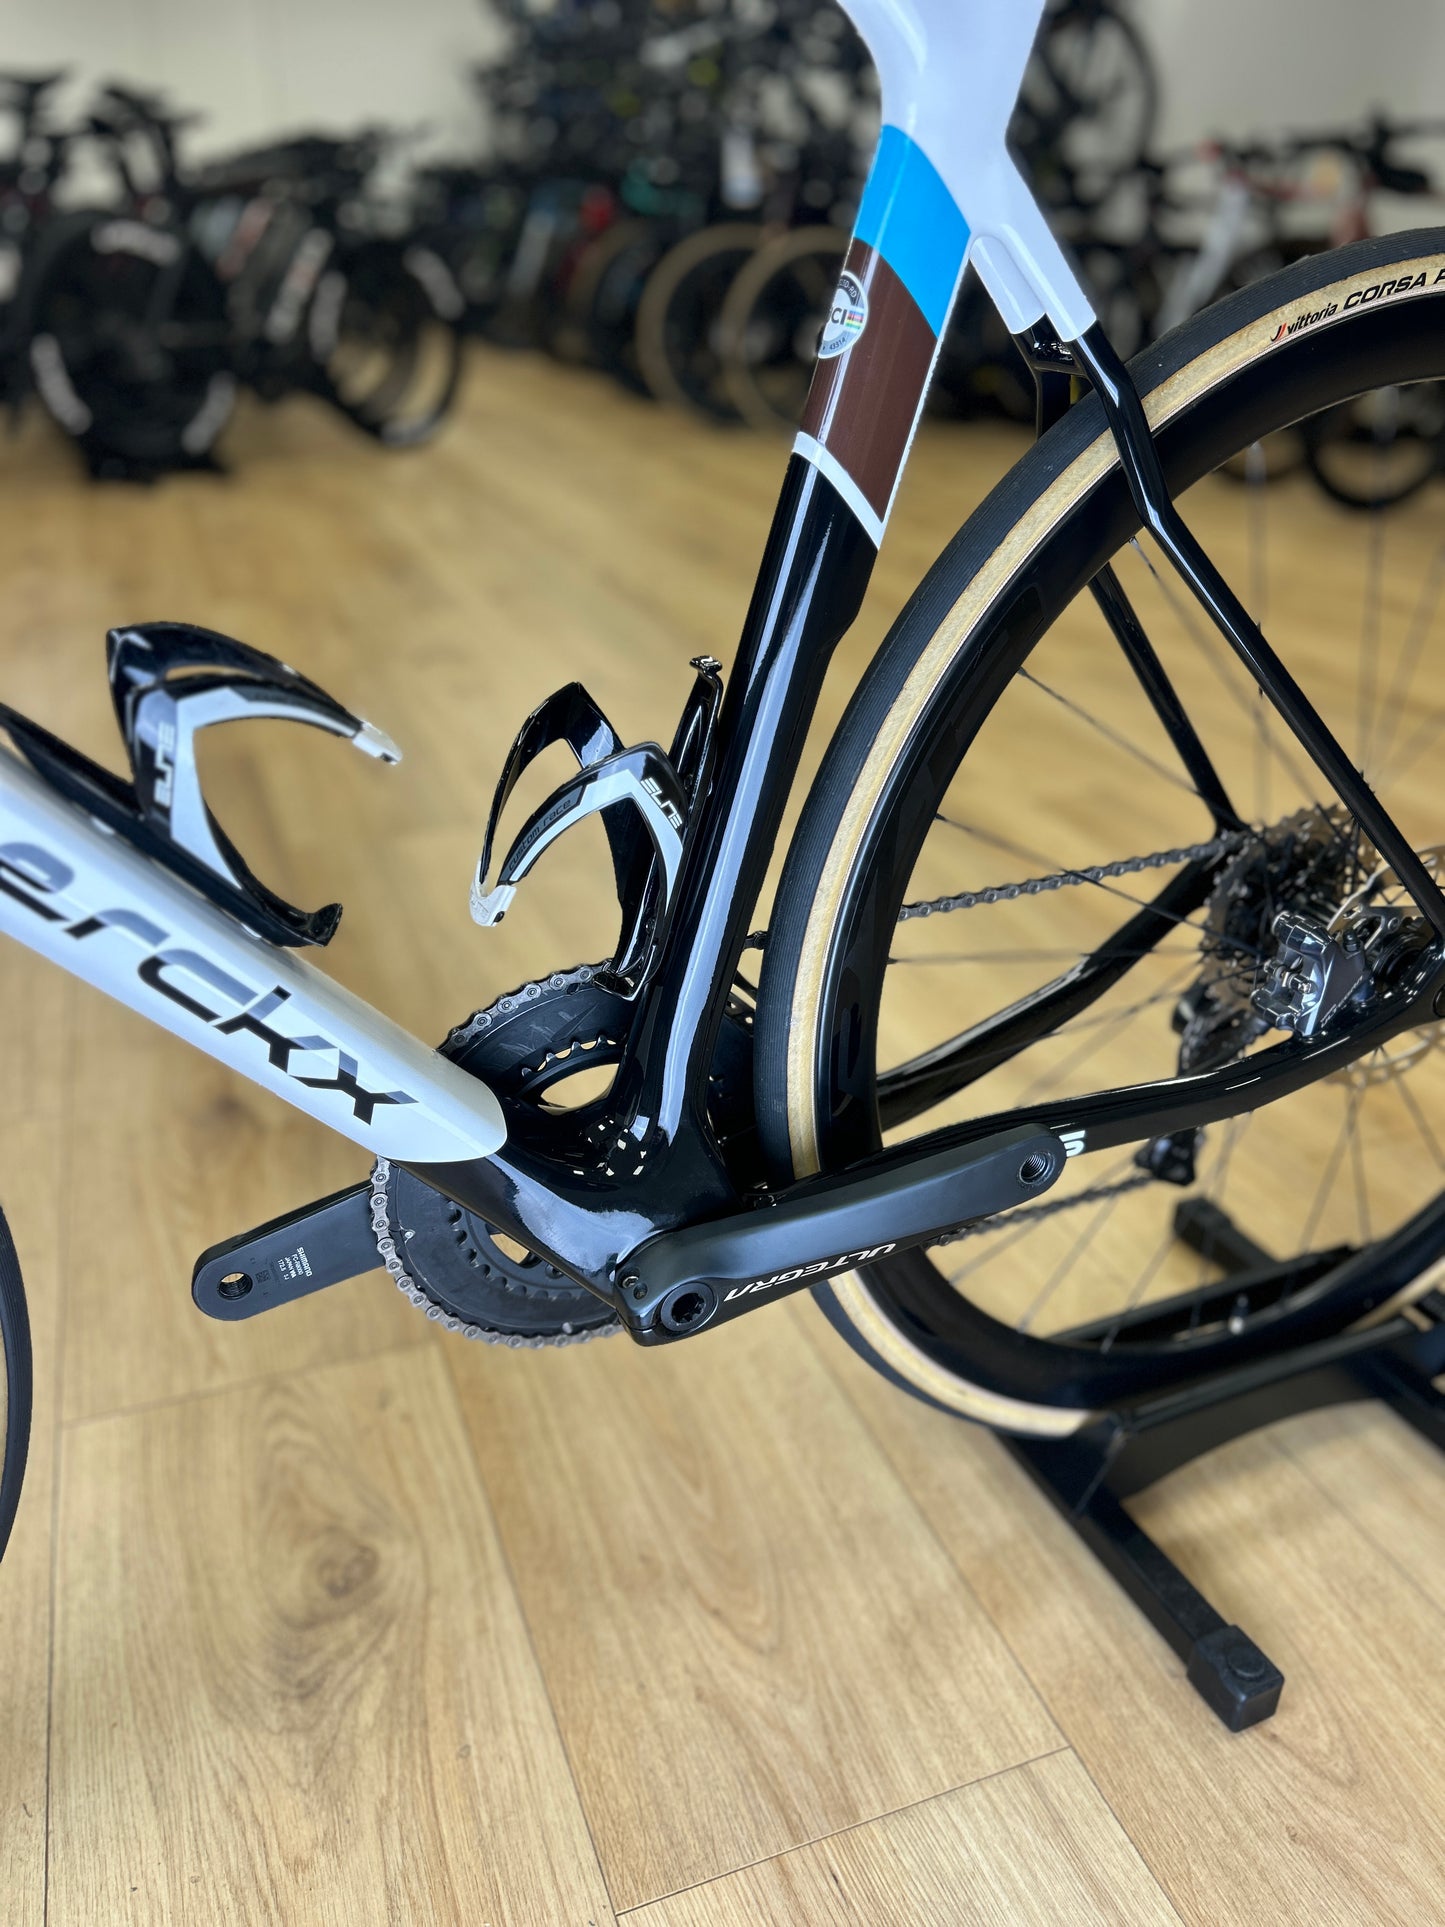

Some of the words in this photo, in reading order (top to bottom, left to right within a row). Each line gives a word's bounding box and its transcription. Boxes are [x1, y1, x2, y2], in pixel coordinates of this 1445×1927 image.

[831, 307, 848, 325] CI
[1287, 302, 1338, 334] vittoria
[1343, 272, 1427, 310] CORSA
[508, 826, 541, 872] custom
[542, 799, 572, 828] race
[297, 1246, 313, 1277] SHIMANO
[723, 1243, 896, 1302] ULTEGRA
